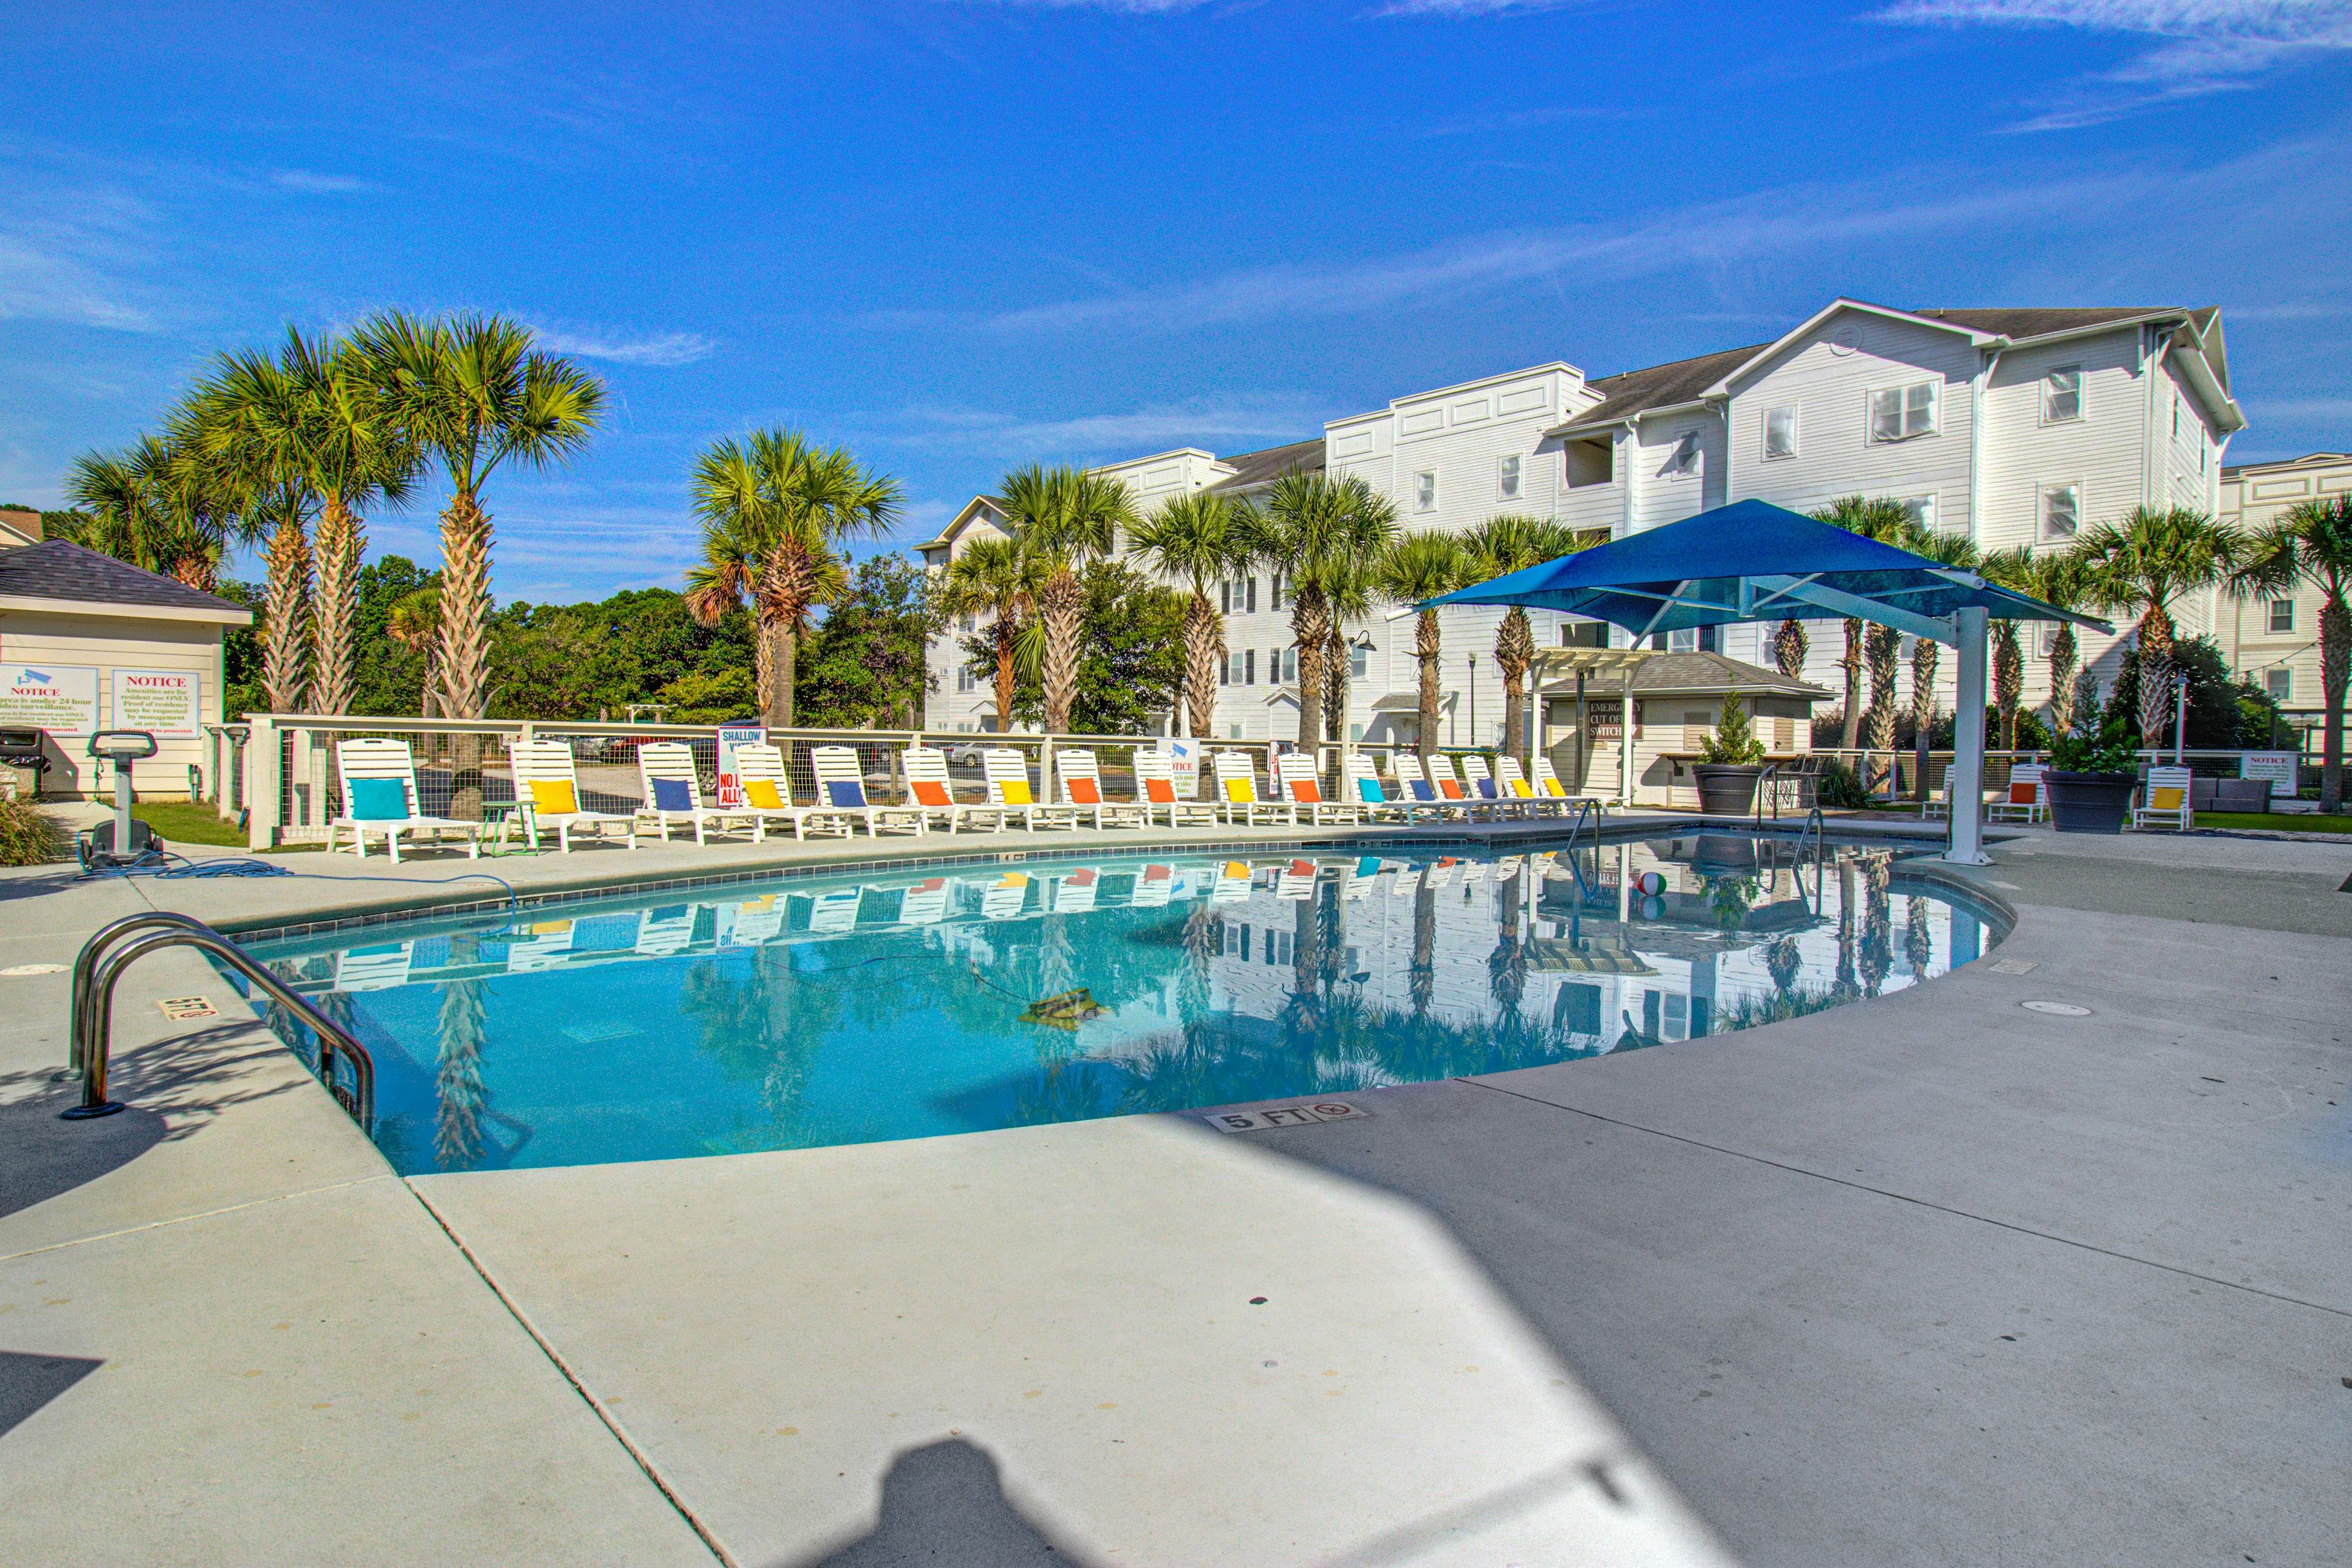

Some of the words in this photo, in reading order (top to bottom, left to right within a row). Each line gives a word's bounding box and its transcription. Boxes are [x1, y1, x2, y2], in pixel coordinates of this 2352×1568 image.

[126, 675, 186, 687] NOTICE
[10, 688, 60, 696] NOTICE
[1590, 715, 1607, 724] CUT
[722, 731, 760, 741] SHALLOW
[1590, 727, 1622, 736] SWITCH
[720, 774, 732, 788] NO
[1220, 1115, 1254, 1128] 5
[1260, 1108, 1308, 1124] FT
